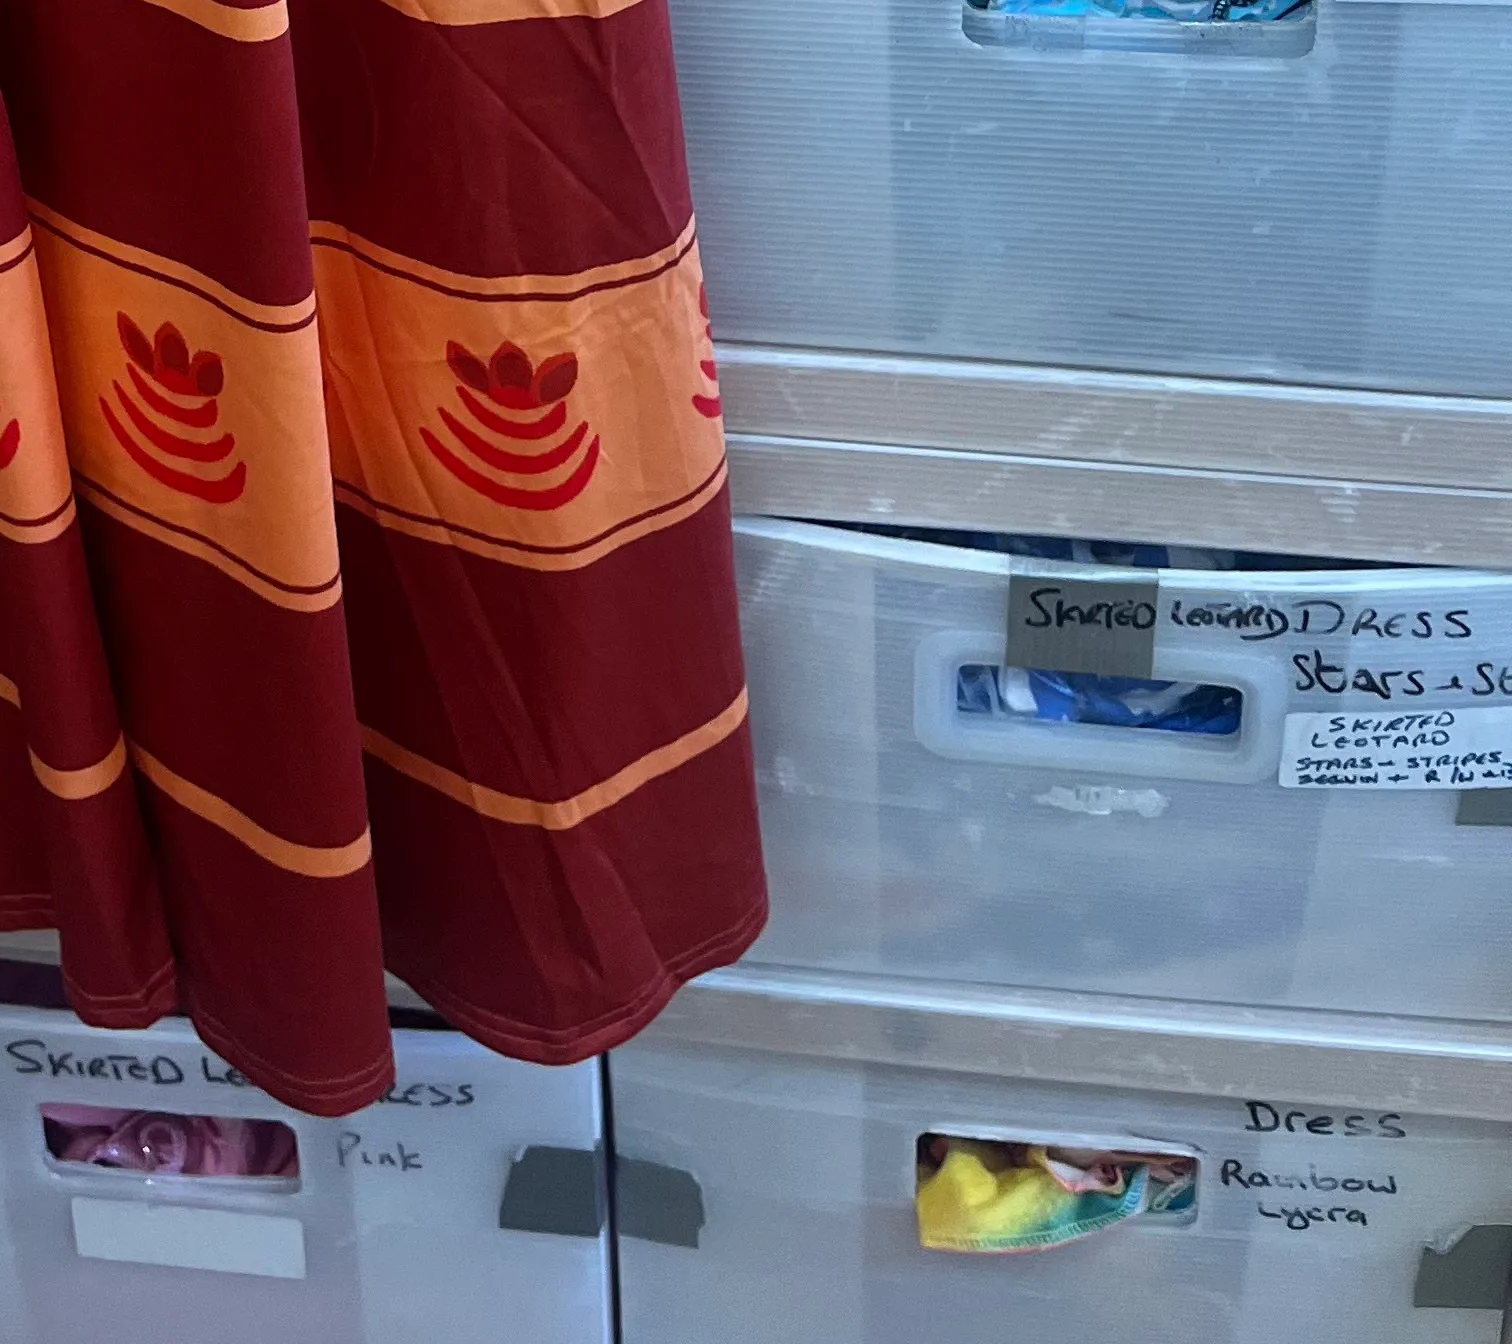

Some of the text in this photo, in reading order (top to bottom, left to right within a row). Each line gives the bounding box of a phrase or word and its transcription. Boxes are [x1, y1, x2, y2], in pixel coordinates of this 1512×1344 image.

[1311, 730, 1451, 749] LEOTARD
[1328, 711, 1455, 734] SKIRTED
[5, 1038, 186, 1086] SKIRTED
[1244, 1100, 1407, 1138] Dress
[335, 1130, 424, 1172] Pink
[1220, 1158, 1398, 1195] Rainbow
